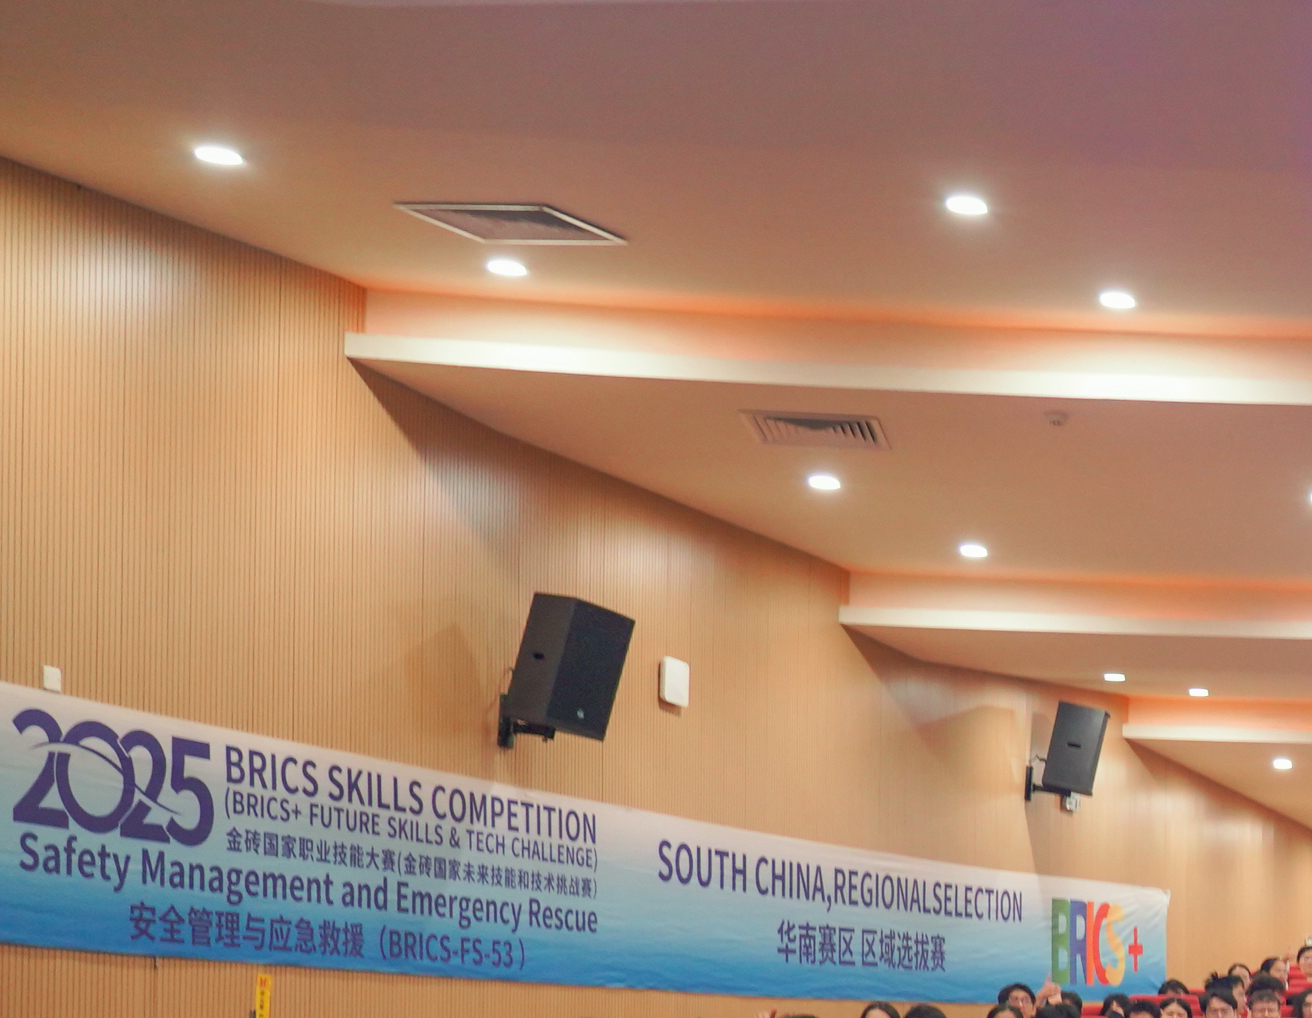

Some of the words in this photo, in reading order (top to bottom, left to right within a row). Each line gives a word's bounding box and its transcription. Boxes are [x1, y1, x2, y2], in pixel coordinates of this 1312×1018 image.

[12, 708, 215, 846] 2025
[225, 744, 319, 798] BRICS
[328, 764, 424, 816] SKILLS
[431, 785, 597, 845] COMPETITION
[225, 786, 302, 823] (BRICS+
[309, 802, 381, 836] FUTURE
[387, 816, 443, 846] SKILLS
[449, 826, 461, 850] &
[466, 829, 506, 856] TECH
[511, 837, 598, 873] CHALLENGE)
[18, 831, 131, 893] Safety
[141, 847, 335, 906] Management
[341, 876, 388, 912] and
[396, 880, 522, 934] Emergency
[528, 897, 598, 934] Rescue
[658, 839, 747, 893] SOUTH
[755, 855, 1022, 923] CHINA,REGIONALSELECTION
[129, 900, 364, 958] 安全管理与应急救援
[776, 919, 856, 967] 华南赛区
[861, 928, 946, 973] 区域选拔赛
